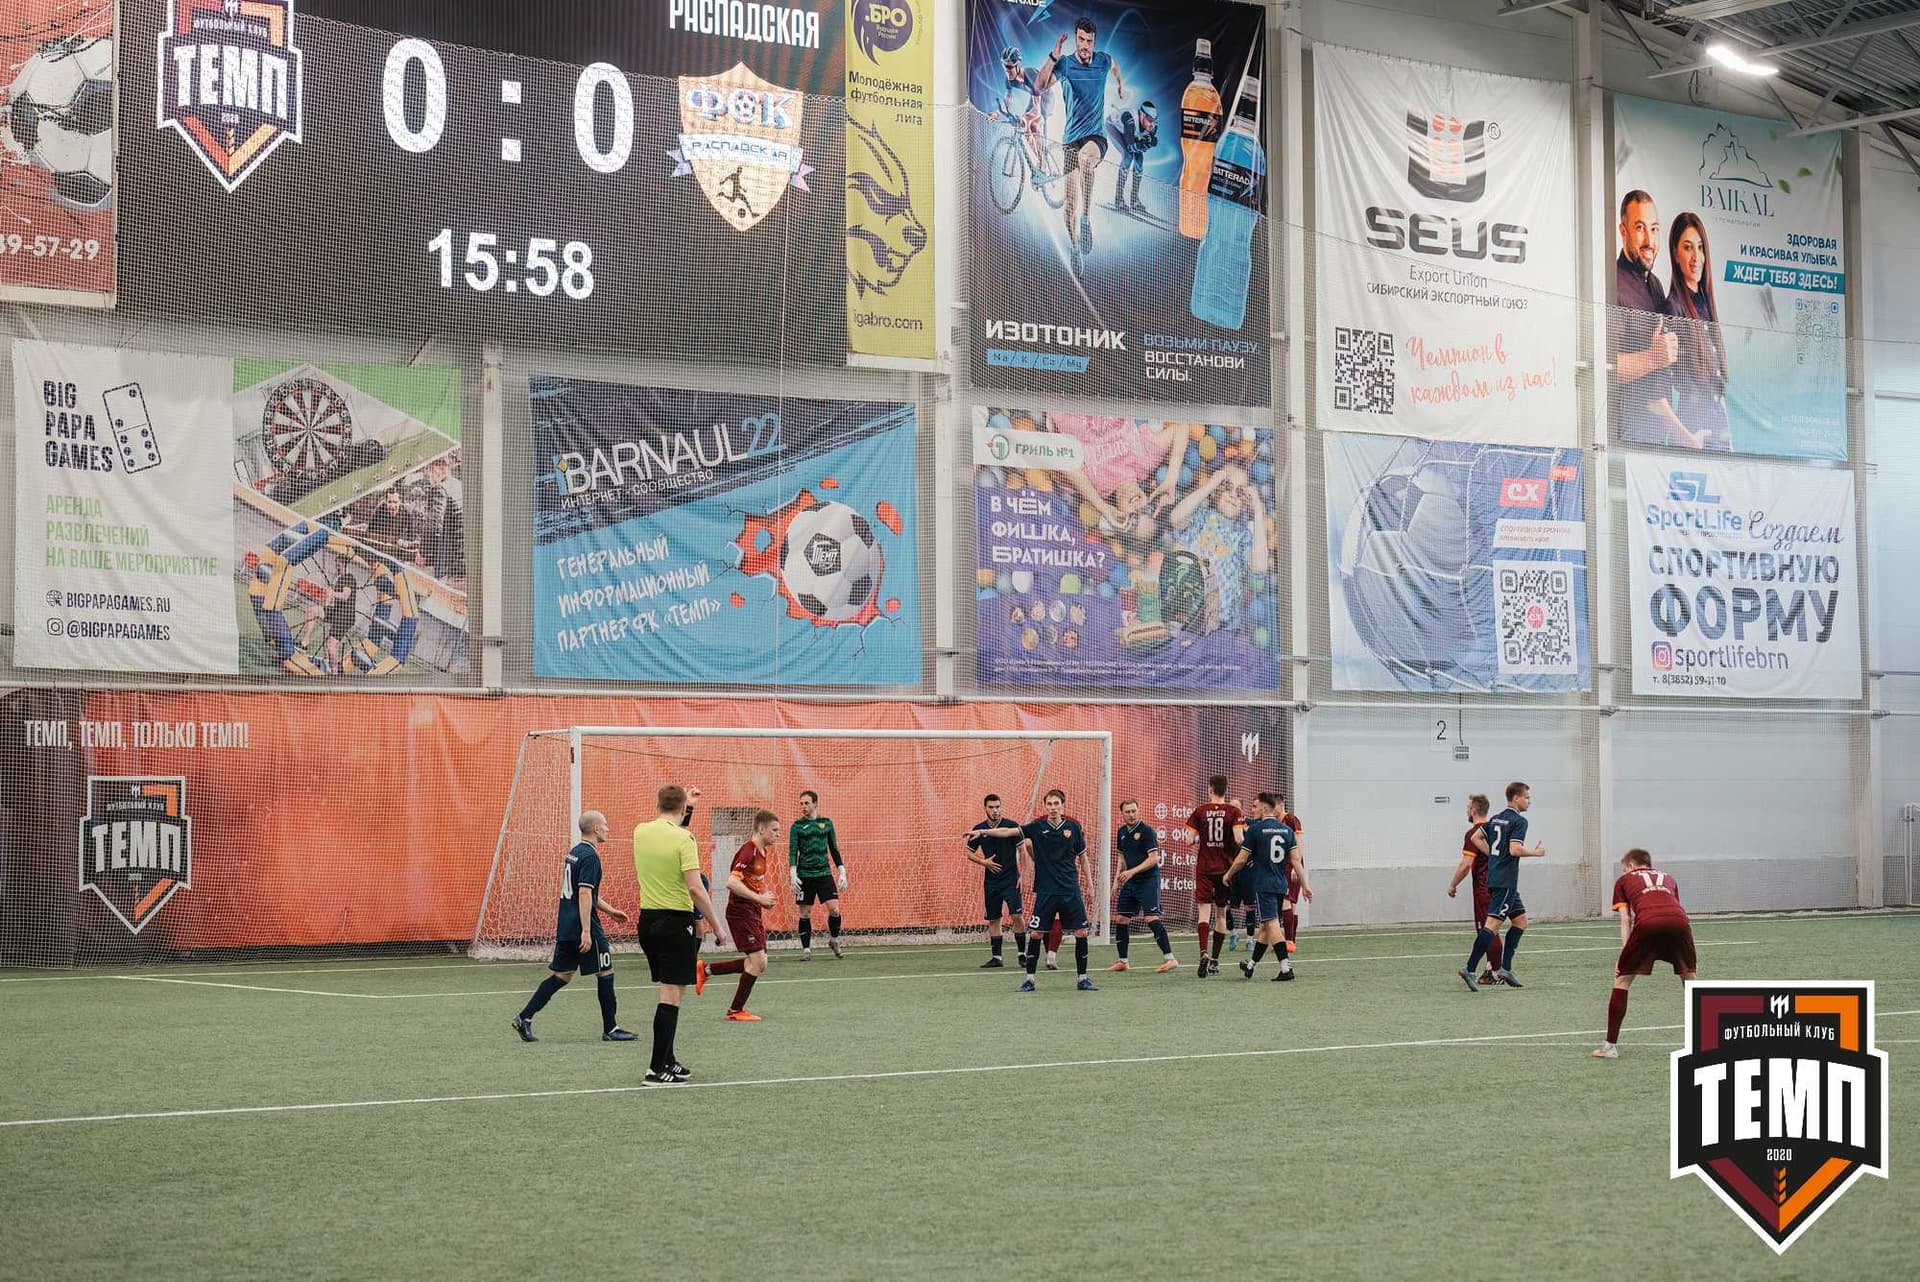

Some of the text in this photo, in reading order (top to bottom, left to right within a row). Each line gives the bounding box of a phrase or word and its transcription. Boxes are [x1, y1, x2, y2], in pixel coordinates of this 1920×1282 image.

[669, 0, 819, 49] РАСПАДСКАЯ
[173, 44, 288, 120] ТЕМП
[848, 70, 923, 95] Молодёжная
[383, 38, 447, 153] 0
[574, 61, 635, 173] 0
[850, 87, 923, 110] футбольная
[895, 113, 923, 126] лига
[1700, 184, 1775, 217] BAIKAL
[1365, 206, 1528, 264] SEUS
[1786, 233, 1837, 251] ЗДОРОВАЯ
[428, 228, 594, 300] 15:58
[1740, 243, 1838, 267] И КРАСИВАЯ УЛЫБКА
[1409, 264, 1488, 289] Export Union
[1732, 264, 1838, 290] ЖДЕТ ТЕБЯ ЗДЕСЬ!
[1366, 281, 1429, 302] СИБИРСКИЙ
[1430, 289, 1500, 309] ЭКСПОРТНЫЙ
[985, 319, 1127, 351] ИЗОТОНИК
[1143, 333, 1207, 351] ВОЗЬМИ
[1145, 350, 1245, 369] ВОССТАНОВИ
[1405, 335, 1490, 370] Чемпион
[1146, 366, 1193, 382] СИЛЫ.
[44, 380, 77, 409] BIG
[45, 411, 96, 442] PAPA
[45, 444, 113, 472] GAMES
[1015, 443, 1054, 457] ГРИЛЬ
[46, 494, 103, 519] АРЕНДА
[991, 489, 1052, 517] В ЧЁМ
[1646, 504, 1743, 532] SportLife
[1748, 509, 1846, 551] Создаем
[46, 520, 151, 548] РАЗВЛЕЧЕНИЙ
[991, 521, 1077, 547] ФИШКА,
[46, 546, 218, 577] НА ВАШЕ МЕРОПРИЯТИЕ
[556, 533, 670, 580] ГЕНЕРАЛЬНЫЙ
[992, 545, 1106, 569] БРАТИШКА?
[1648, 545, 1840, 584] СПОРТИВНУЮ
[66, 591, 171, 613] BIGPAPAGAMES.RU
[558, 559, 711, 619] ИНФОРМАЦИОННЫЙ
[557, 597, 721, 652] ПАРТНЕР ФК «ТЕМП»
[1649, 583, 1840, 643] ФОРМУ
[66, 619, 171, 641] @BIGPAPAGAMES
[1675, 645, 1789, 673] sportlifebrn
[25, 720, 249, 751] ТЕМП, ТЕМП, ТОЛЬКО ТЕМП!
[1436, 720, 1447, 740] 2
[1172, 803, 1197, 818] fcte
[1206, 818, 1225, 842] 18
[1491, 825, 1501, 856] 2
[92, 821, 181, 873] ТЕМП
[1172, 850, 1197, 866] fc.te
[1270, 835, 1286, 863] 6
[1173, 877, 1197, 891] fcte
[1638, 871, 1667, 888] 17
[1500, 903, 1510, 916] 2
[600, 952, 611, 968] 10
